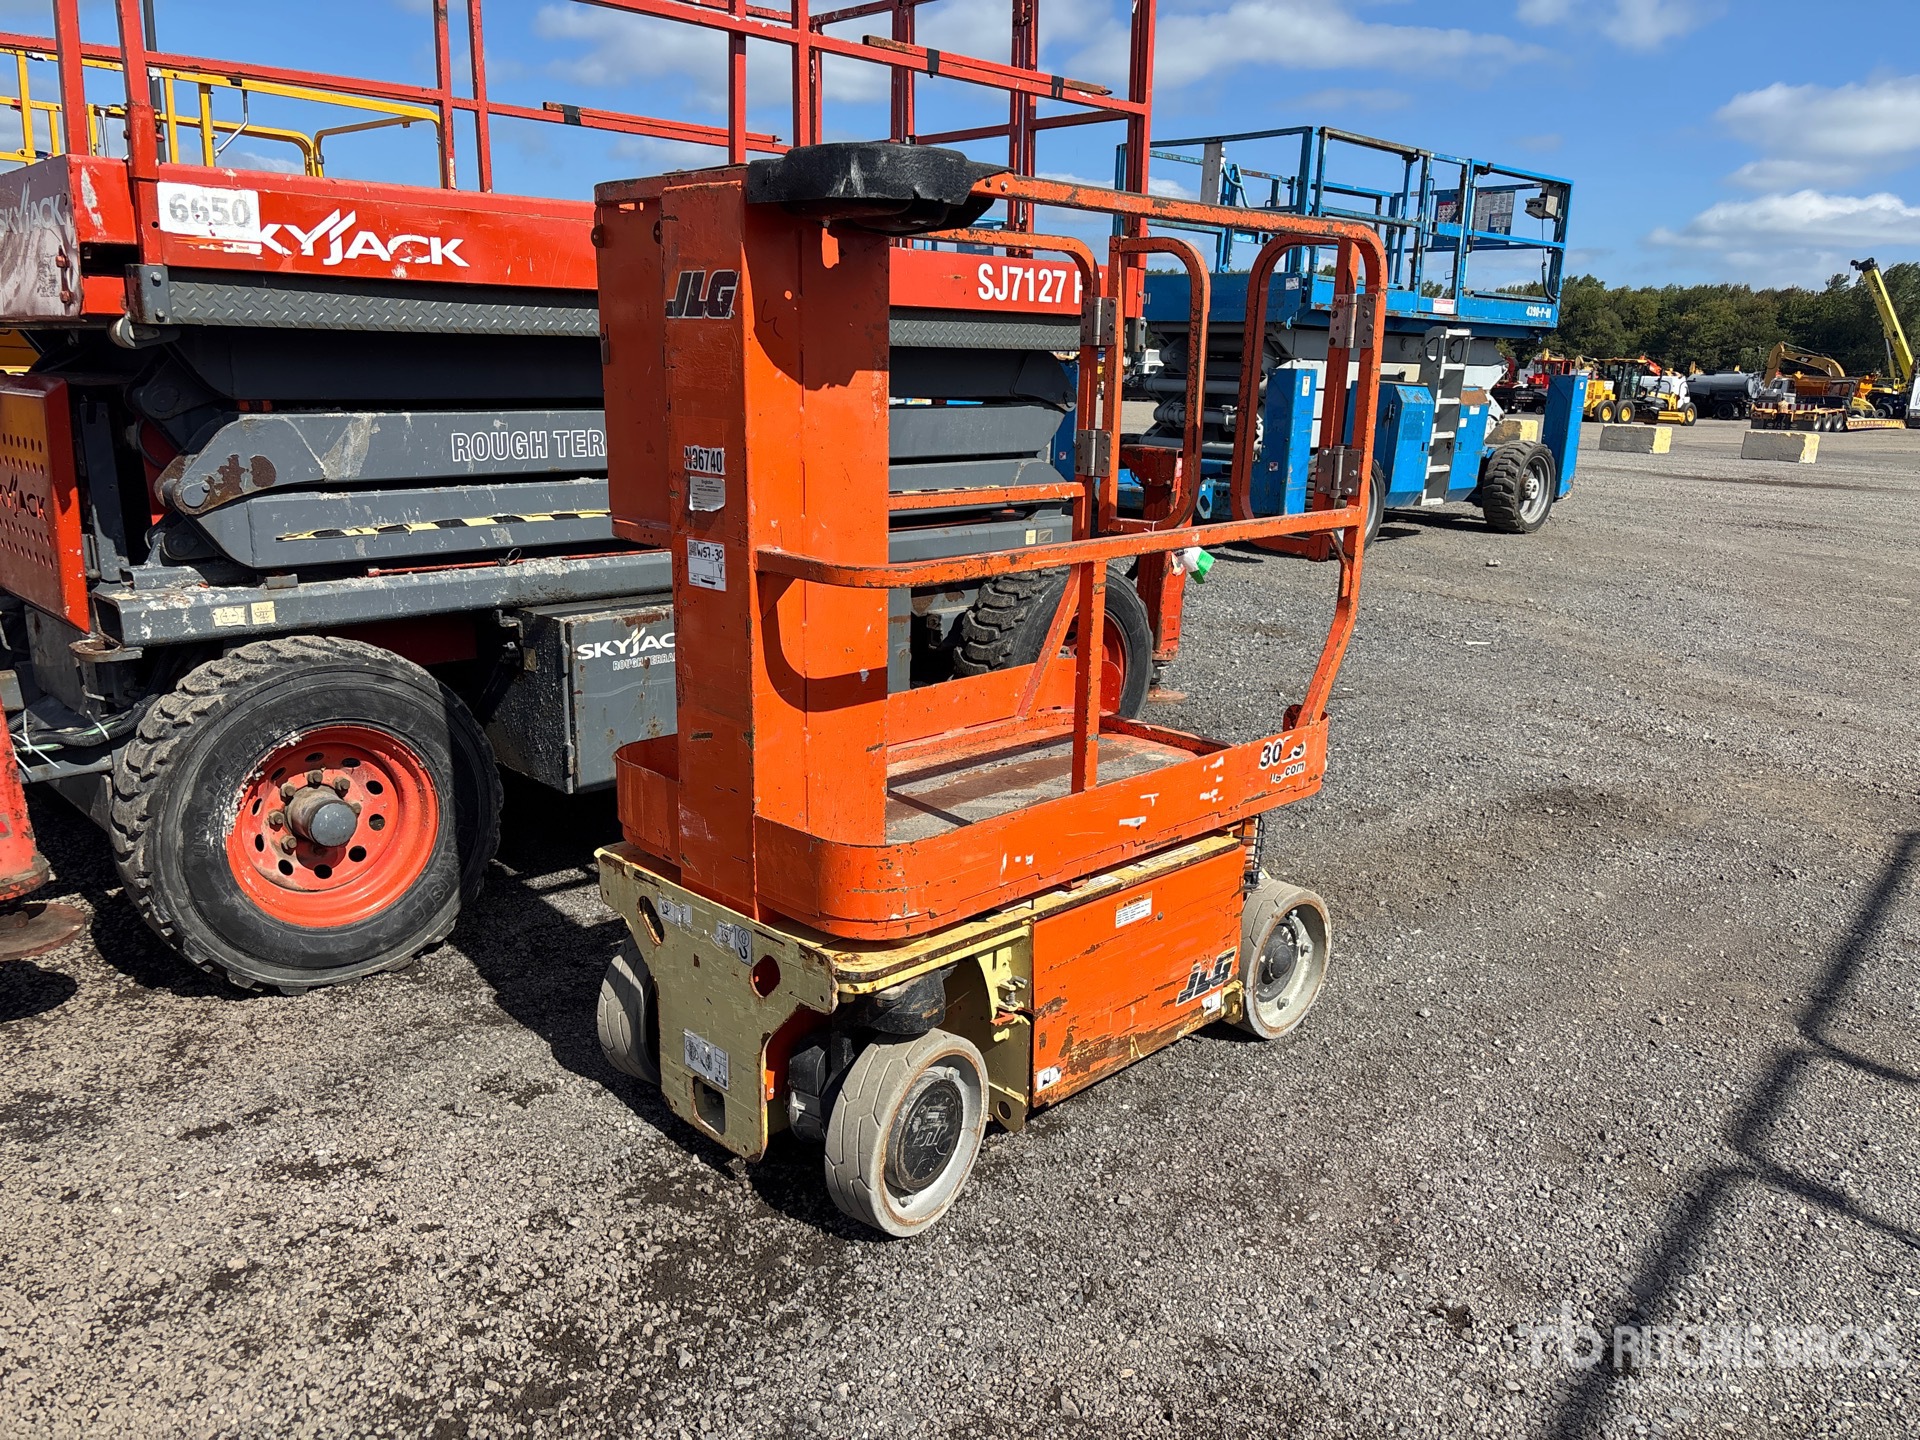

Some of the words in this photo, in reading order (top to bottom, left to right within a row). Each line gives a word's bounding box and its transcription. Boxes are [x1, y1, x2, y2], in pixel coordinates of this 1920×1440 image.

[169, 193, 251, 227] 6650
[260, 208, 470, 268] KYJACK
[666, 269, 740, 319] JLG
[977, 263, 1067, 304] SJ7127
[451, 431, 548, 462] ROUGH
[553, 429, 606, 458] TER
[576, 626, 675, 660] SKYJAC
[1175, 946, 1238, 1007] JLG
